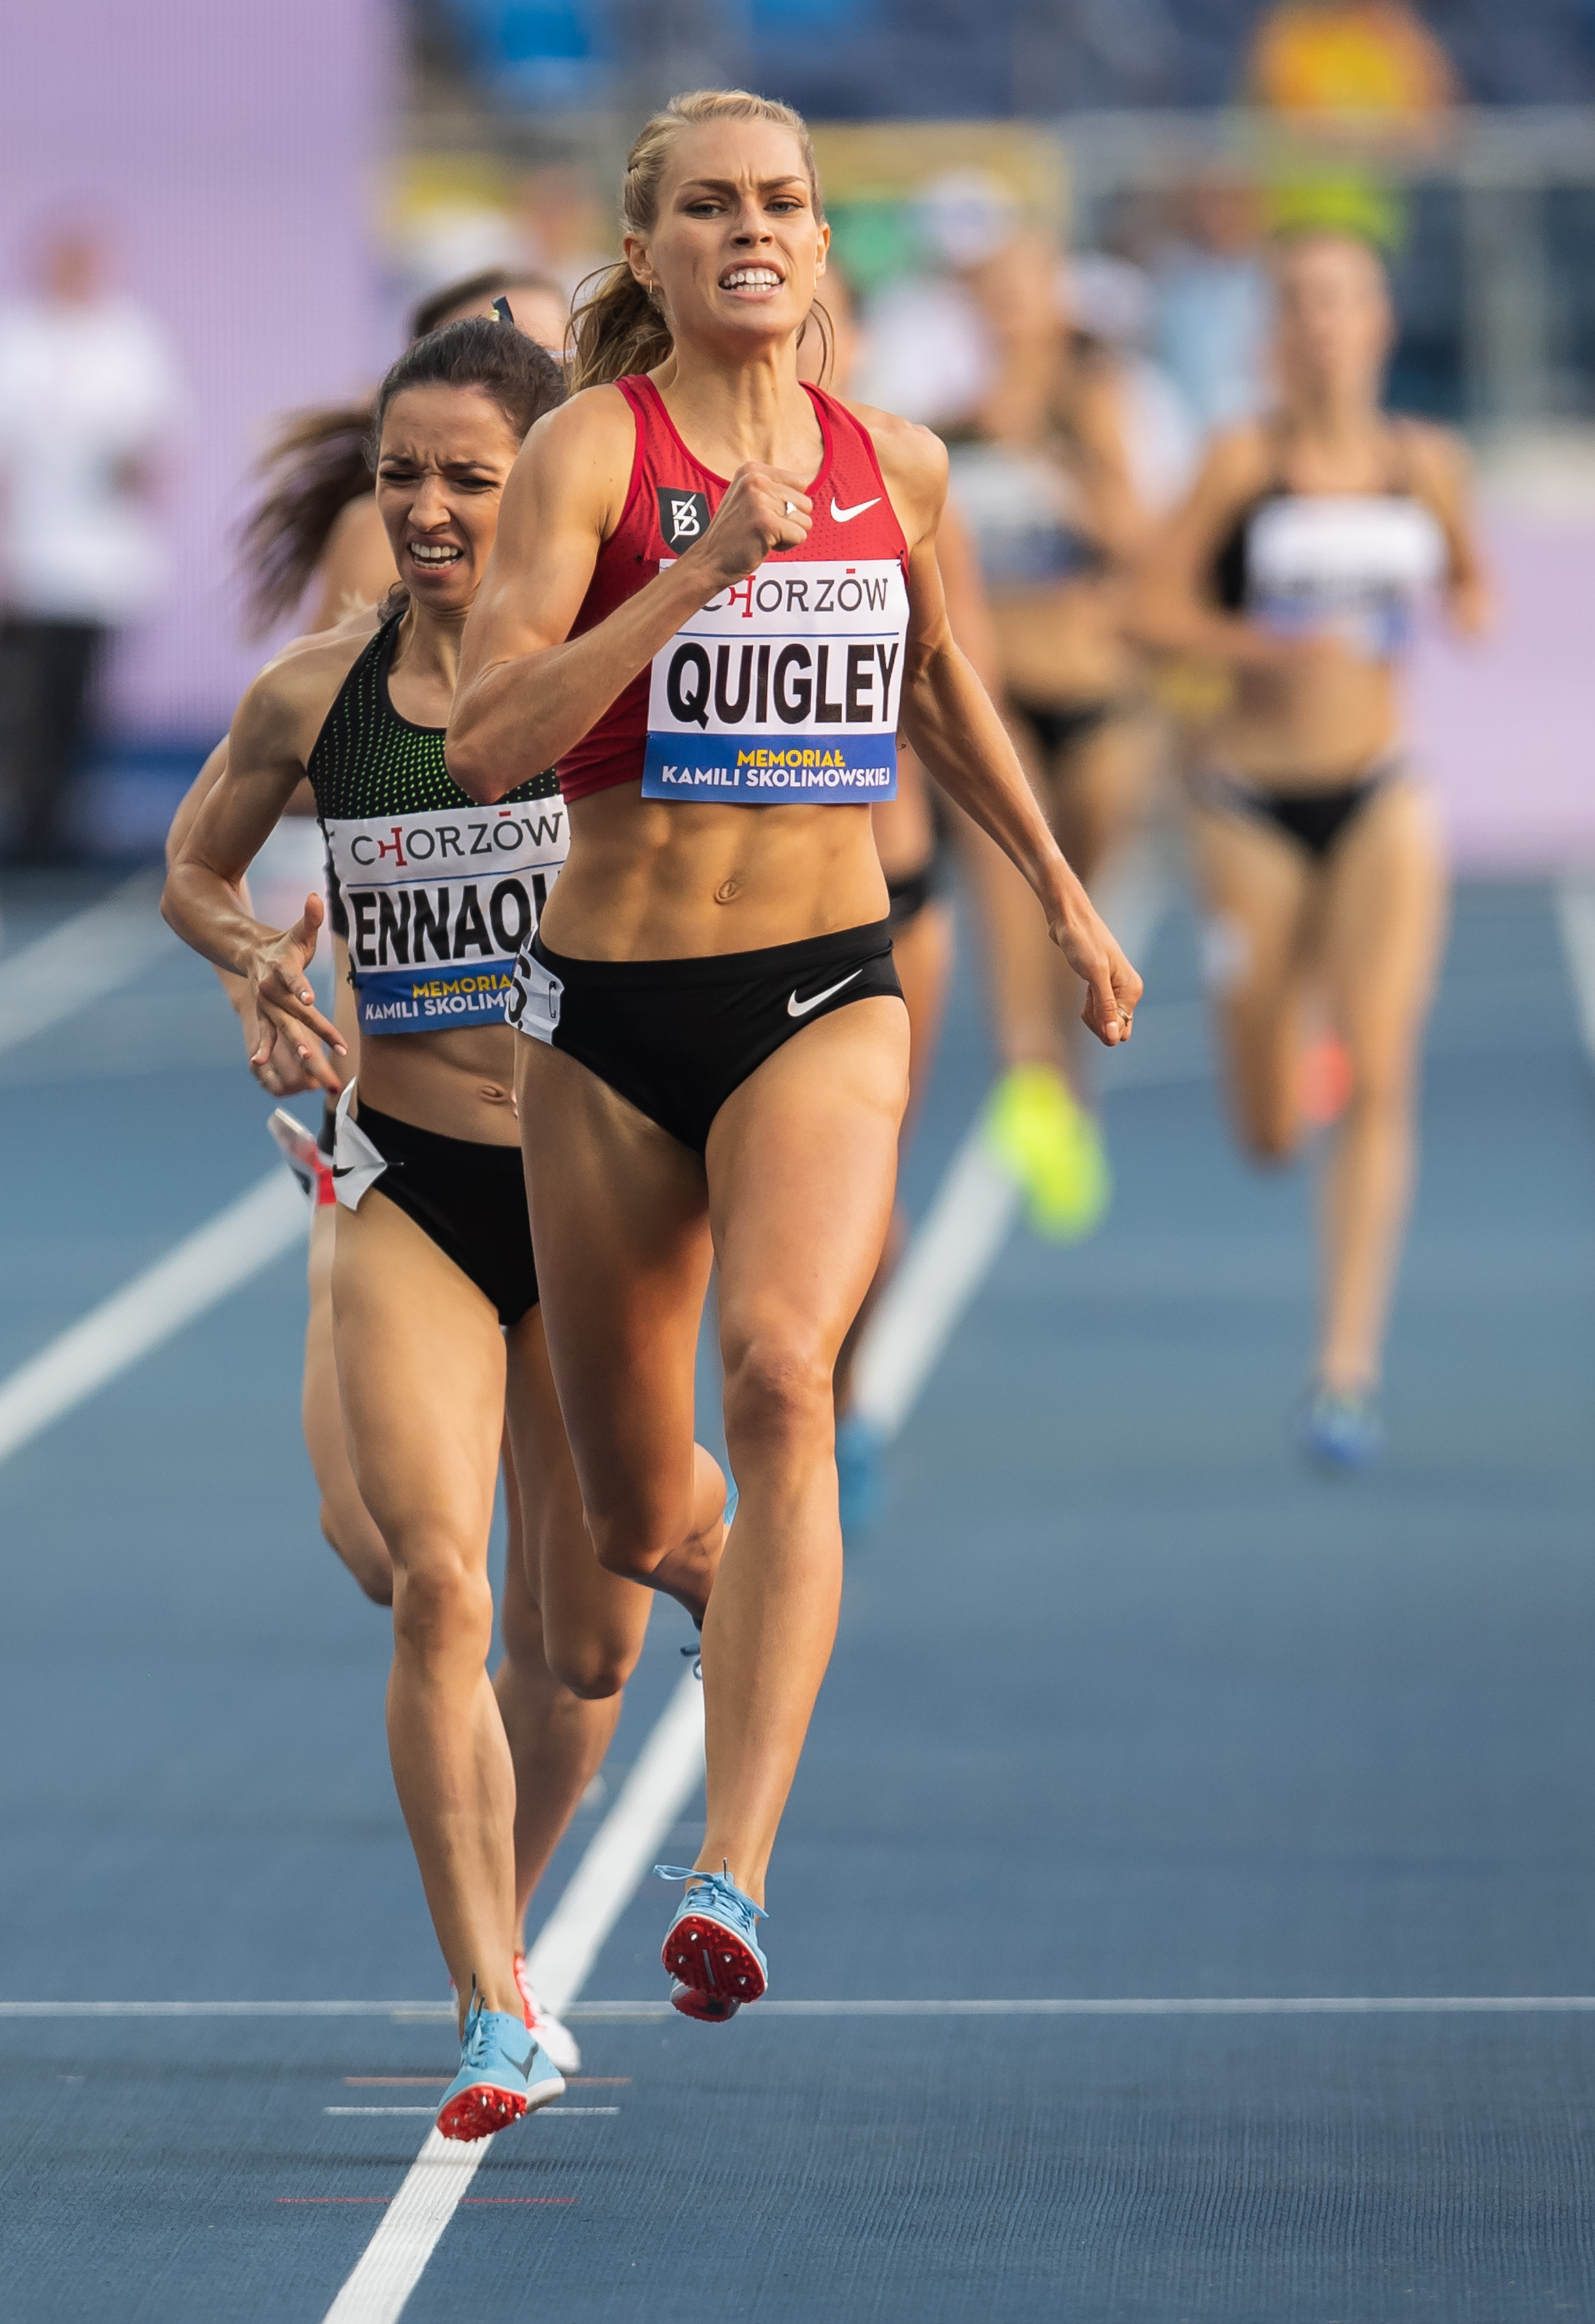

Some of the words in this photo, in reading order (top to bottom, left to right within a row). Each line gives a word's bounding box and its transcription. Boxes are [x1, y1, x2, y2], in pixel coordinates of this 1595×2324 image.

[701, 568, 888, 618] HORZÓW
[666, 641, 899, 731] QUIGLEY
[737, 749, 846, 768] MEMORIAŁ
[662, 765, 741, 787] KAMILI
[745, 767, 890, 788] SKOLIMOWSKIEJ
[413, 972, 515, 998] MEMORIA
[366, 1000, 419, 1021] KAMILI
[423, 989, 511, 1017] SKOLIM
